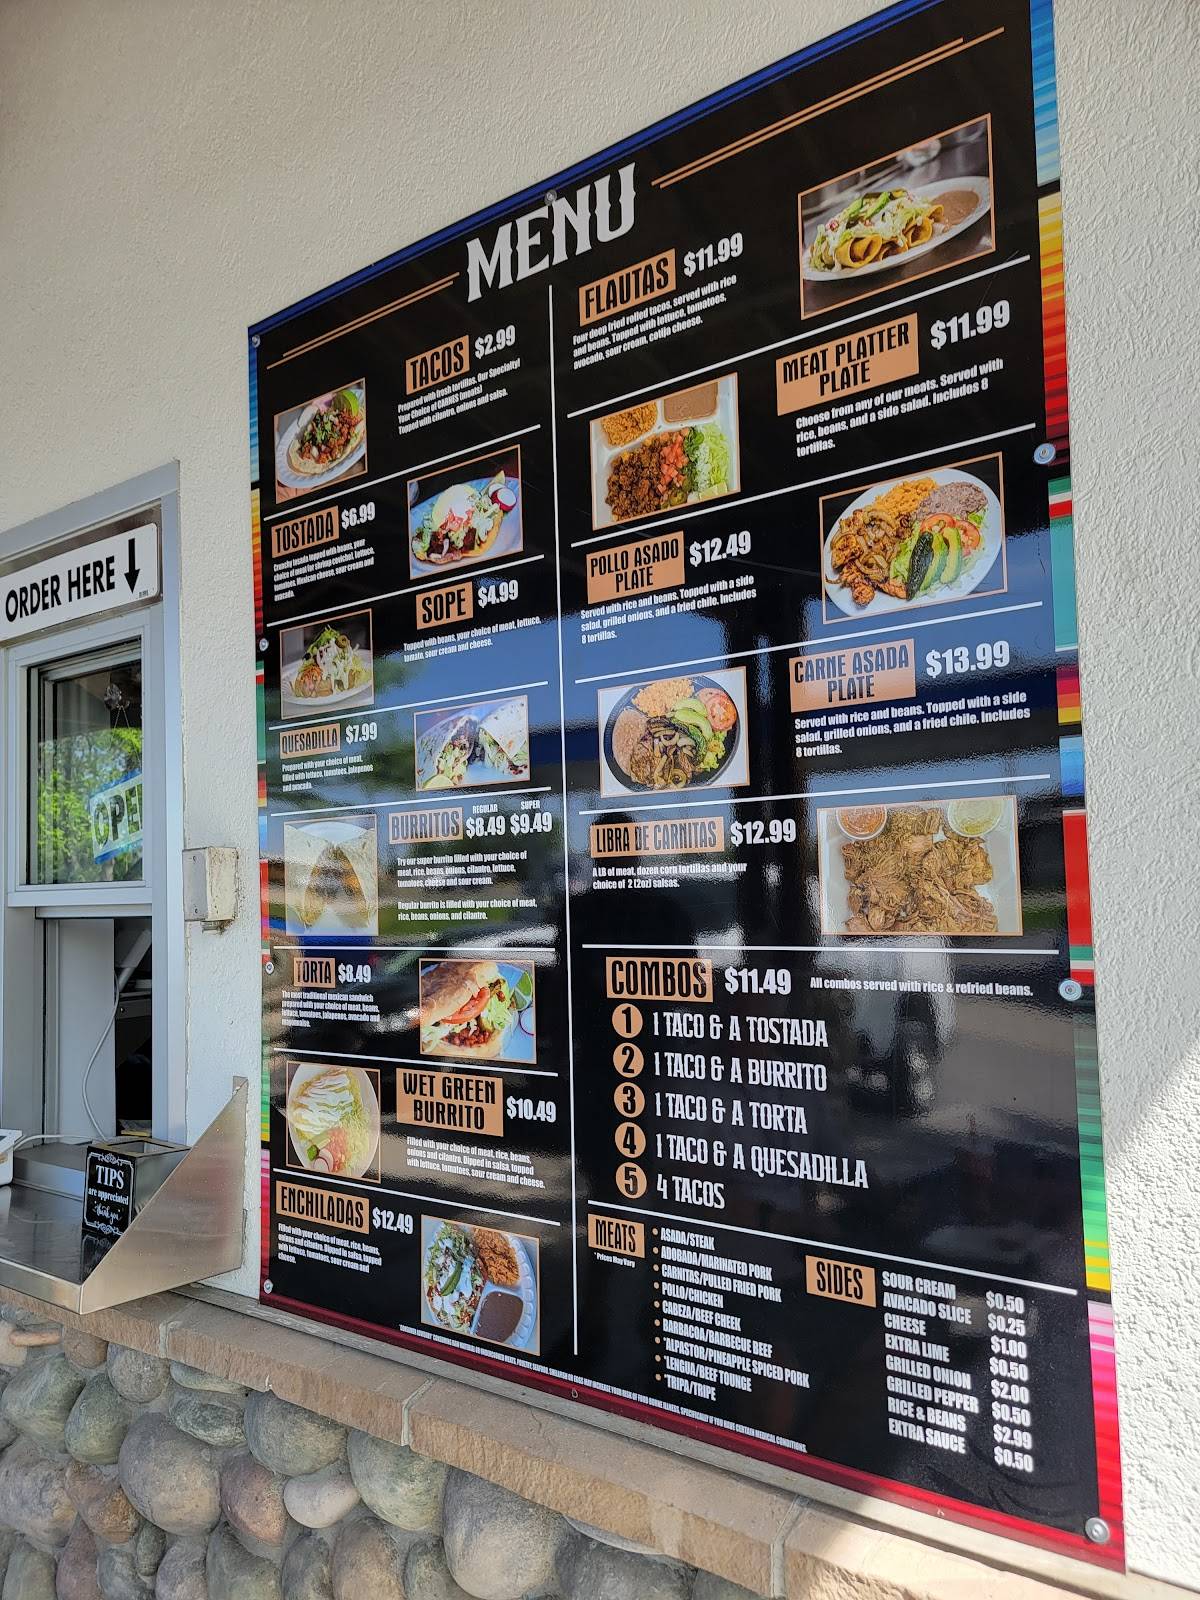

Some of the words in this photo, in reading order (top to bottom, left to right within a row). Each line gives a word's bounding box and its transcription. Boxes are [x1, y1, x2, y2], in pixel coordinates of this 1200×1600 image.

[466, 161, 637, 303] MENU
[585, 256, 668, 318] FLAUTAS
[683, 230, 743, 279] $11.99
[930, 298, 1010, 351] $11.99
[410, 340, 463, 390] TACOS
[475, 322, 515, 360] $2.99
[783, 348, 828, 383] MEAT
[835, 321, 909, 367] PLATTER
[819, 359, 870, 396] PLATE
[275, 511, 333, 553] TOSTADA
[341, 500, 375, 530] $6.99
[590, 550, 628, 577] POLLO
[634, 538, 678, 567] ASADO
[689, 528, 751, 568] $12.49
[5, 574, 62, 622] ORDER
[68, 555, 115, 602] HERE
[616, 566, 653, 592] PLATE
[422, 588, 465, 624] SOPE
[477, 578, 518, 609] $4.99
[794, 654, 846, 683] CARNE
[852, 644, 908, 674] ASADA
[925, 639, 1009, 679] $13.99
[827, 675, 874, 702] PLATE
[794, 715, 826, 729] Served
[828, 712, 848, 725] with
[849, 710, 868, 723] rice
[870, 707, 889, 720] and
[891, 703, 924, 718] beans.
[926, 698, 965, 715] Topped
[967, 695, 990, 709] with
[993, 696, 999, 706] a
[1002, 690, 1026, 705] side
[795, 730, 822, 744] salad,
[823, 726, 854, 741] grilled
[856, 722, 891, 737] onions,
[893, 720, 912, 732] and
[914, 721, 920, 730] a
[922, 715, 947, 729] fried
[949, 712, 979, 726] chile.
[981, 706, 1030, 723] Includes
[282, 727, 337, 754] QUESADILLA
[345, 720, 377, 745] $7.99
[796, 746, 802, 757] 8
[803, 742, 842, 756] tortillas.
[472, 803, 497, 814] REGULAR
[521, 800, 540, 810] SUPER
[391, 810, 459, 840] BURRITOS
[466, 814, 505, 838] $8.49
[510, 811, 552, 836] $9.49
[596, 827, 629, 853] LIBRA
[635, 825, 649, 850] DE
[653, 820, 717, 850] CARNITAS
[730, 818, 796, 847] $12.99
[296, 960, 331, 983] TORTA
[338, 963, 371, 985] $8.49
[611, 960, 706, 999] COMBOS
[724, 966, 791, 996] $11.49
[810, 977, 822, 988] All
[824, 978, 861, 990] combos
[863, 979, 897, 991] served
[899, 980, 920, 992] with
[922, 980, 943, 993] rice
[946, 982, 953, 993] &
[955, 981, 992, 995] refried
[994, 982, 1033, 996] beans.
[621, 1006, 631, 1033] 1
[652, 1011, 659, 1035] 1
[663, 1012, 705, 1039] TACO
[709, 1014, 723, 1040] &
[728, 1015, 741, 1041] A
[746, 1016, 828, 1047] TOSTADA
[621, 1045, 634, 1073] 2
[653, 1051, 660, 1076] 1
[664, 1052, 706, 1080] TACO
[710, 1055, 724, 1082] &
[729, 1057, 742, 1083] A
[747, 1058, 827, 1091] BURRITO
[403, 1072, 435, 1097] WET
[442, 1076, 495, 1104] GREEN
[413, 1098, 484, 1130] BURRITO
[506, 1095, 556, 1125] $10.49
[622, 1085, 635, 1114] 3
[655, 1091, 661, 1116] 1
[665, 1093, 707, 1122] TACO
[711, 1097, 726, 1124] &
[731, 1099, 744, 1126] A
[749, 1101, 807, 1134] TORTA
[96, 1165, 124, 1189] TIPS
[622, 1125, 636, 1154] 4
[656, 1132, 662, 1158] 1
[666, 1134, 708, 1165] TACO
[712, 1140, 727, 1168] &
[732, 1142, 745, 1170] A
[750, 1145, 868, 1192] QUESADILLA
[88, 1188, 97, 1196] are
[98, 1191, 128, 1206] appreciated
[624, 1165, 637, 1195] 5
[656, 1173, 667, 1199] 4
[672, 1175, 724, 1209] TACOS
[281, 1185, 363, 1229] ENCHILADAS
[372, 1206, 413, 1236] $12.49
[595, 1218, 635, 1252] MEATS
[660, 1227, 714, 1250] ASADA/STEAK
[661, 1246, 747, 1276] ADOBADA/MARINATED
[748, 1263, 772, 1281] PORK
[816, 1261, 863, 1300] SIDES
[661, 1264, 732, 1292] CARNITAS/PULLED
[733, 1279, 756, 1297] FRIED
[757, 1284, 781, 1303] PORK
[661, 1282, 723, 1308] POLLO/CHICKEN
[882, 1271, 913, 1292] SOUR
[915, 1277, 956, 1300] CREAM
[985, 1289, 1025, 1315] $0.50
[662, 1300, 713, 1325] CABEZA/BEEF
[714, 1312, 740, 1331] CHEEK
[882, 1291, 936, 1317] AVACADO
[937, 1302, 971, 1325] SLICE
[987, 1312, 1025, 1338] $0.25
[662, 1318, 751, 1353] BARBACOA/BARBECUE
[752, 1340, 772, 1358] BEEF
[884, 1312, 926, 1336] CHEESE
[990, 1335, 1027, 1360] $1.00
[751, 1359, 783, 1381] SPICED
[784, 1368, 809, 1388] PORK
[885, 1333, 920, 1356] EXTRA
[922, 1341, 949, 1362] LIME
[989, 1356, 1028, 1383] $0.50
[718, 1369, 751, 1392] TOUNGE
[885, 1354, 931, 1380] GRILLED
[932, 1365, 971, 1390] ONION
[991, 1378, 1029, 1406] $2.00
[886, 1375, 932, 1402] GRILLED
[934, 1387, 979, 1414] PEPPER
[991, 1400, 1031, 1428] $0.50
[887, 1396, 914, 1418] RICE
[915, 1406, 925, 1421] &
[926, 1406, 966, 1432] BEANS
[993, 1423, 1032, 1451] $2.99
[888, 1417, 924, 1443] EXTRA
[925, 1427, 965, 1454] SAUCE
[993, 1445, 1033, 1474] $0.50
